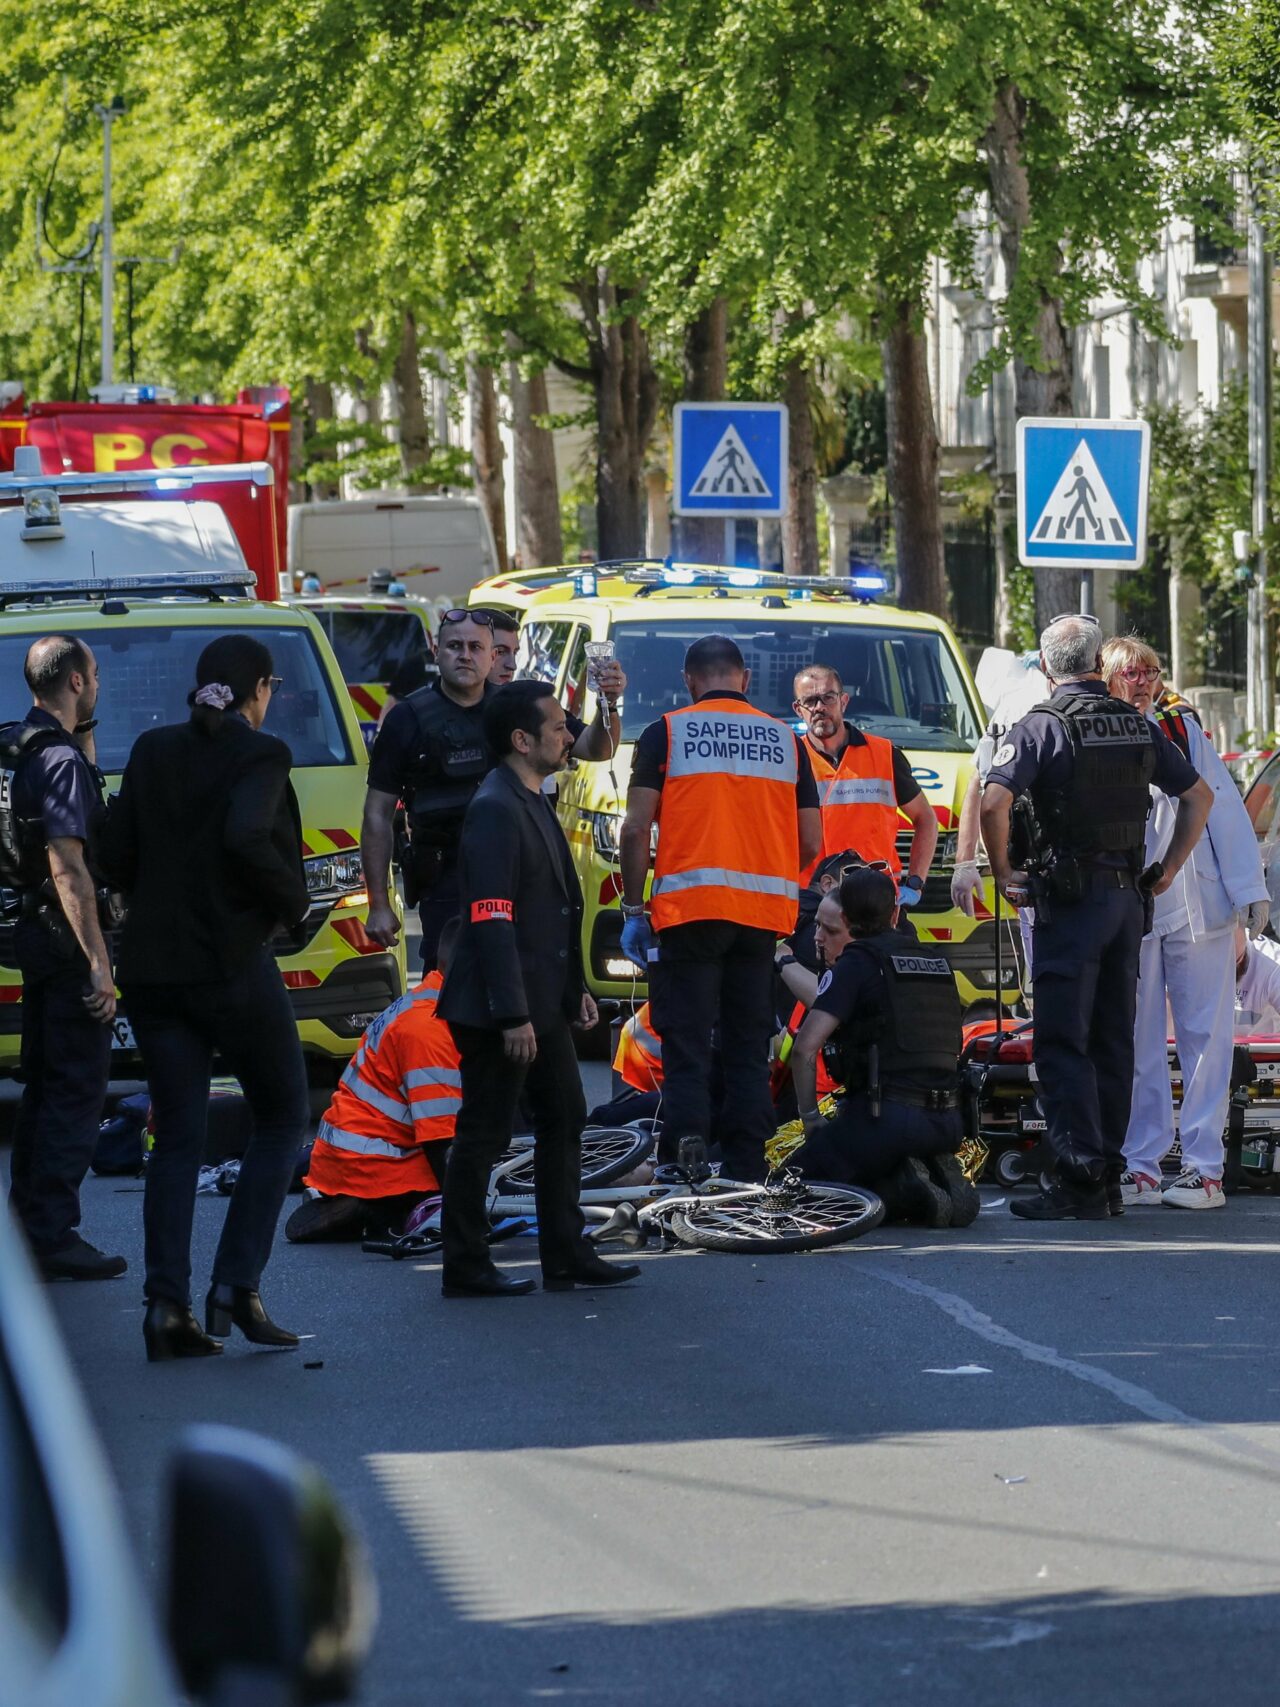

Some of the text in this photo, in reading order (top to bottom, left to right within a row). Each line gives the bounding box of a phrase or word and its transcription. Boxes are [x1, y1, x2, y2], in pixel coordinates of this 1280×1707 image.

[93, 432, 209, 473] PC
[686, 721, 780, 743] SAPEURS
[1081, 716, 1149, 738] POLICE
[684, 740, 785, 764] POMPIERS
[899, 958, 946, 972] POLICE
